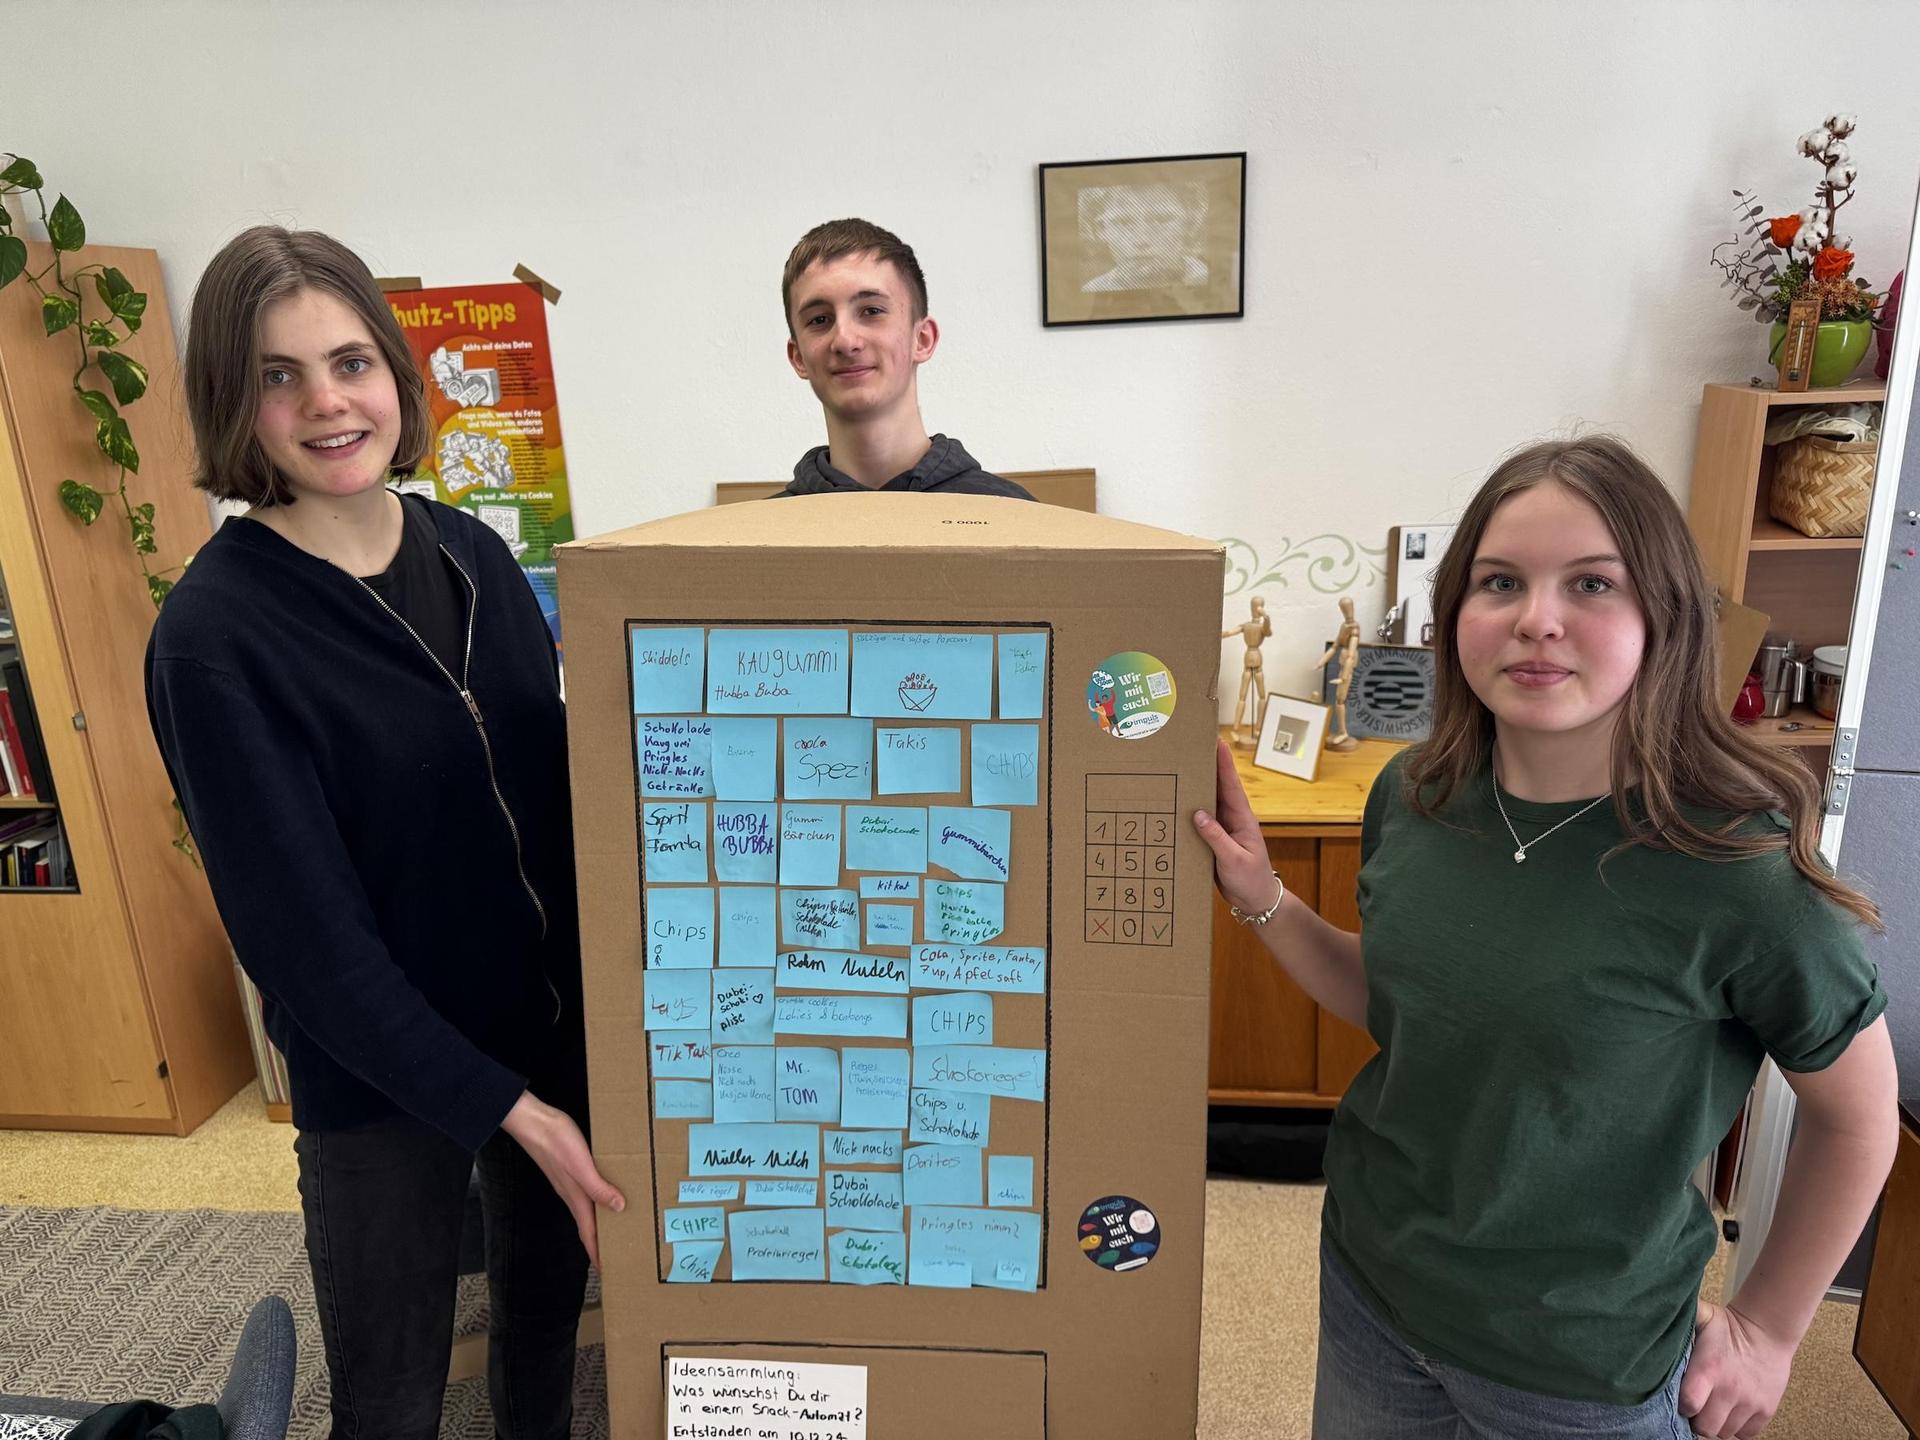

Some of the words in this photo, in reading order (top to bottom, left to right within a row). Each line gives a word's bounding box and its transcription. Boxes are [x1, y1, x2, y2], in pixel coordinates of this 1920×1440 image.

[1118, 672, 1142, 686] Wir
[715, 684, 751, 700] Hubba
[754, 682, 793, 698] Buba
[1124, 684, 1144, 698] mit
[1122, 696, 1150, 712] euch
[885, 733, 928, 750] Takis
[644, 750, 688, 766] Pringles
[798, 753, 869, 787] Spezi
[647, 780, 704, 794] Getränke
[717, 813, 769, 834] HUBBA
[785, 810, 824, 828] Gummi
[1095, 821, 1107, 839] 1
[1124, 820, 1138, 841] 2
[1153, 819, 1167, 843] 3
[722, 834, 774, 857] BUBBA
[1095, 851, 1105, 872] 4
[1124, 851, 1138, 872] 5
[1155, 853, 1169, 872] 6
[937, 884, 973, 899] Chips
[1096, 887, 1107, 902] 7
[1124, 887, 1137, 905] 8
[1153, 886, 1165, 909] 9
[940, 902, 977, 915] Haribo
[653, 919, 707, 942] Chips
[1122, 918, 1137, 938] 0
[920, 947, 955, 964] Cola,
[960, 948, 1001, 966] Sprite,
[841, 957, 905, 982] Nudeln
[931, 1009, 986, 1035] CHIPS
[656, 1044, 683, 1062] Tik
[683, 1042, 710, 1060] Tak
[785, 1060, 811, 1074] Mr.
[780, 1087, 818, 1105] TOM
[915, 1092, 948, 1116] Chips
[920, 1117, 980, 1141] Schokolade
[833, 1136, 858, 1157] Nick
[763, 1149, 809, 1170] Milch
[907, 1153, 961, 1171] Doritos
[920, 1216, 974, 1233] Pringles
[1102, 1213, 1125, 1227] Wir
[1109, 1223, 1128, 1237] mit
[1108, 1234, 1135, 1249] euch
[673, 1362, 801, 1387] Ideensammlung:
[673, 1384, 705, 1398] Was
[712, 1385, 779, 1401] wünschst
[788, 1388, 806, 1402] Du
[810, 1389, 831, 1403] dir
[680, 1401, 692, 1414] in
[702, 1403, 744, 1416] einem
[673, 1424, 752, 1439] Entstanden
[758, 1430, 779, 1439] am
